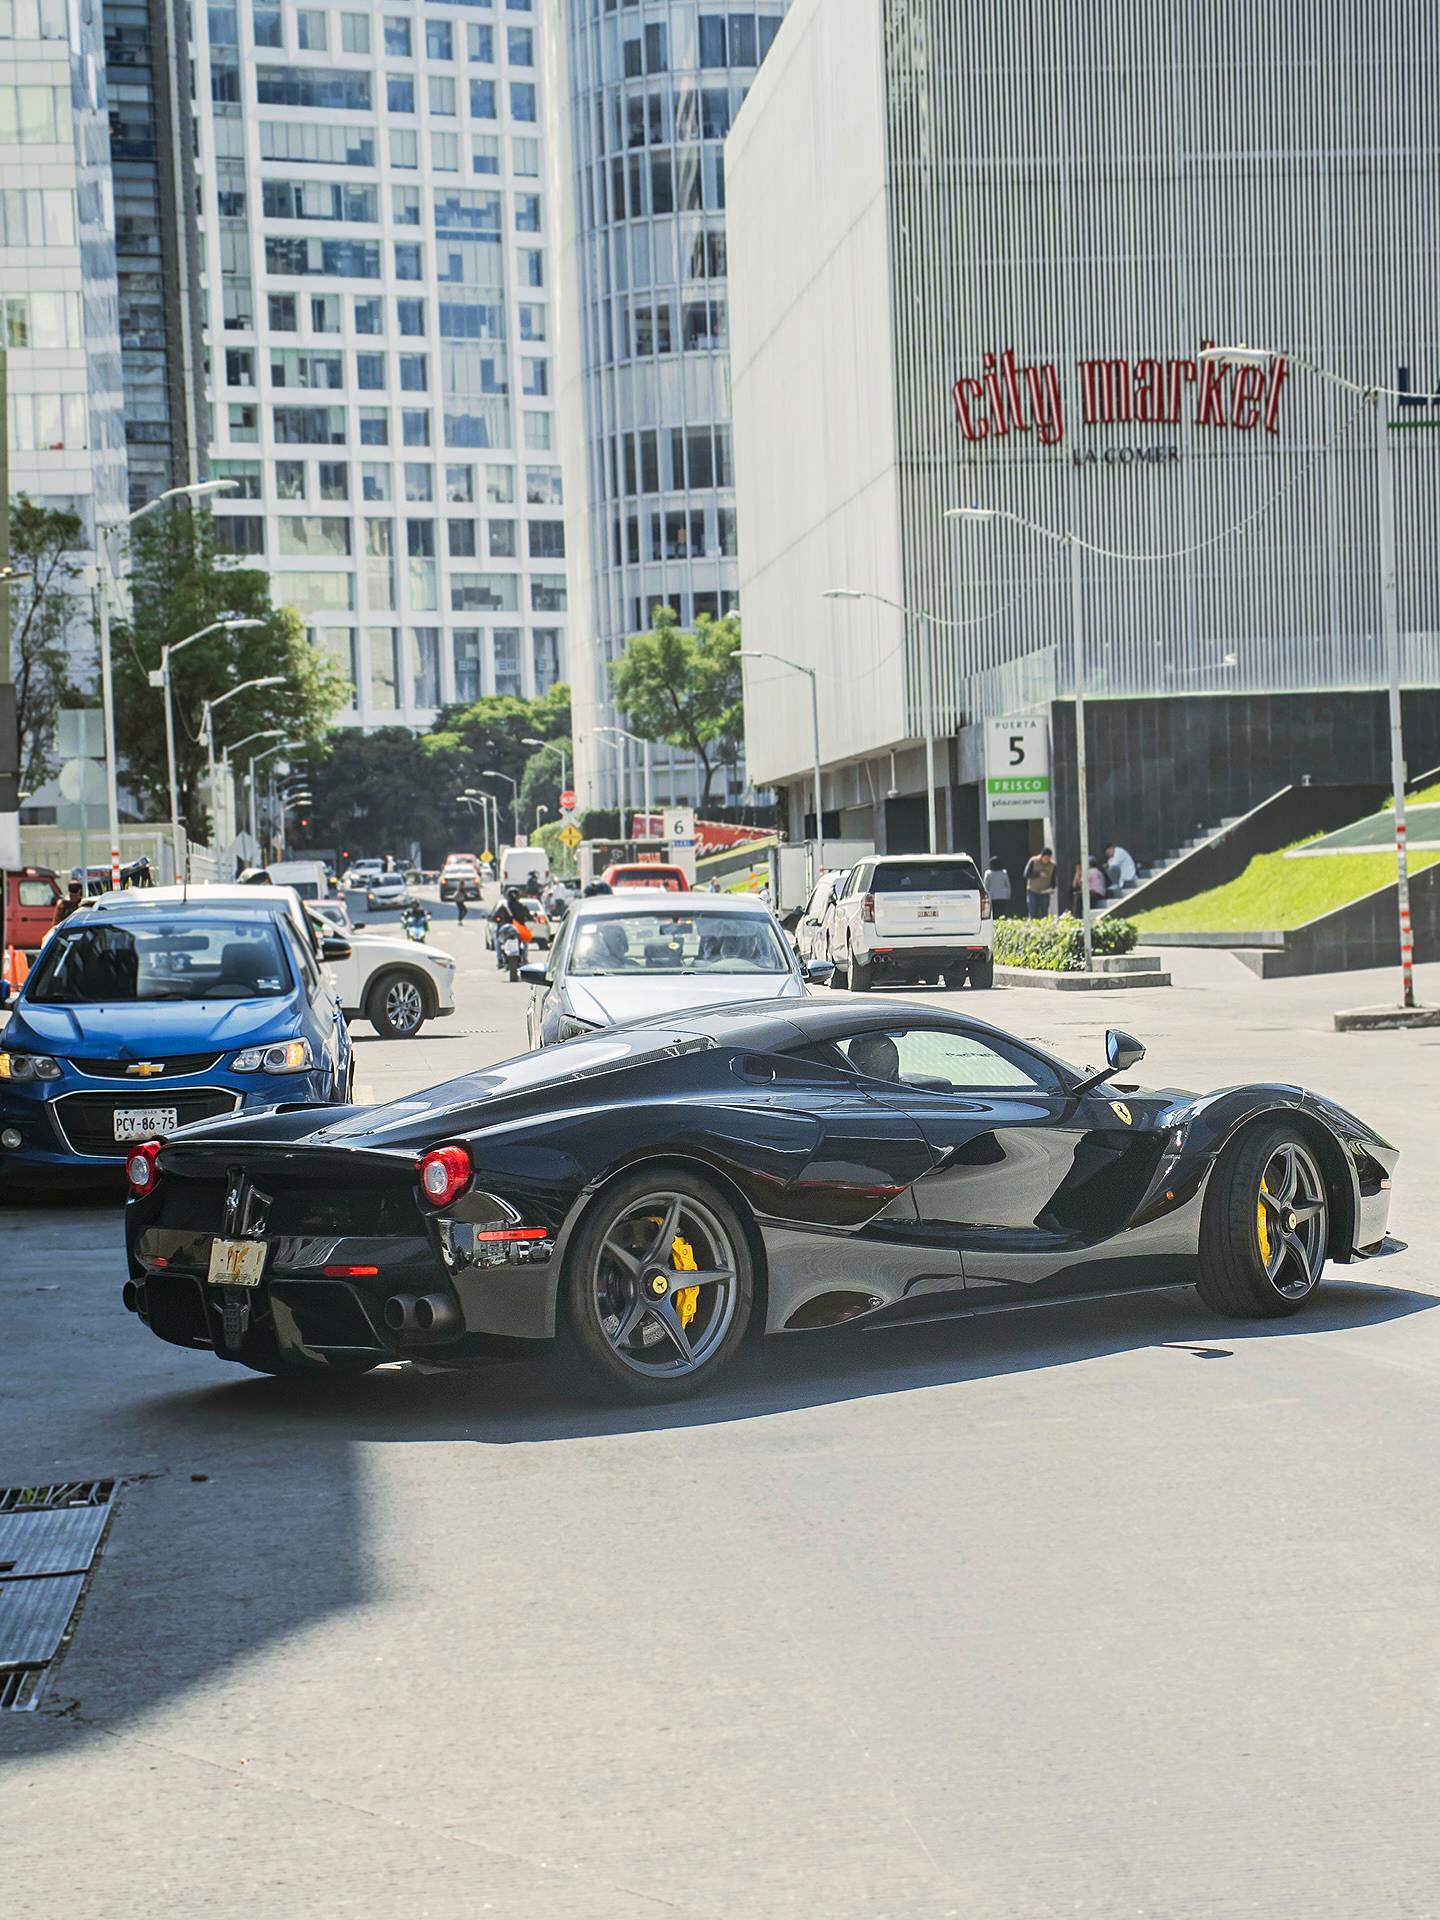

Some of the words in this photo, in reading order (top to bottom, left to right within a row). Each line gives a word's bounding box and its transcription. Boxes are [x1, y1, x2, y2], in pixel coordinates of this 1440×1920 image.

[952, 347, 1064, 445] city
[1079, 338, 1288, 435] market
[1072, 448, 1098, 466] LA
[1104, 446, 1180, 465] COMER
[995, 720, 1037, 729] PUERTA
[1009, 736, 1025, 766] 5
[994, 780, 1042, 791] FRISCO
[673, 820, 684, 835] 6
[116, 1116, 175, 1132] PCY-86-75
